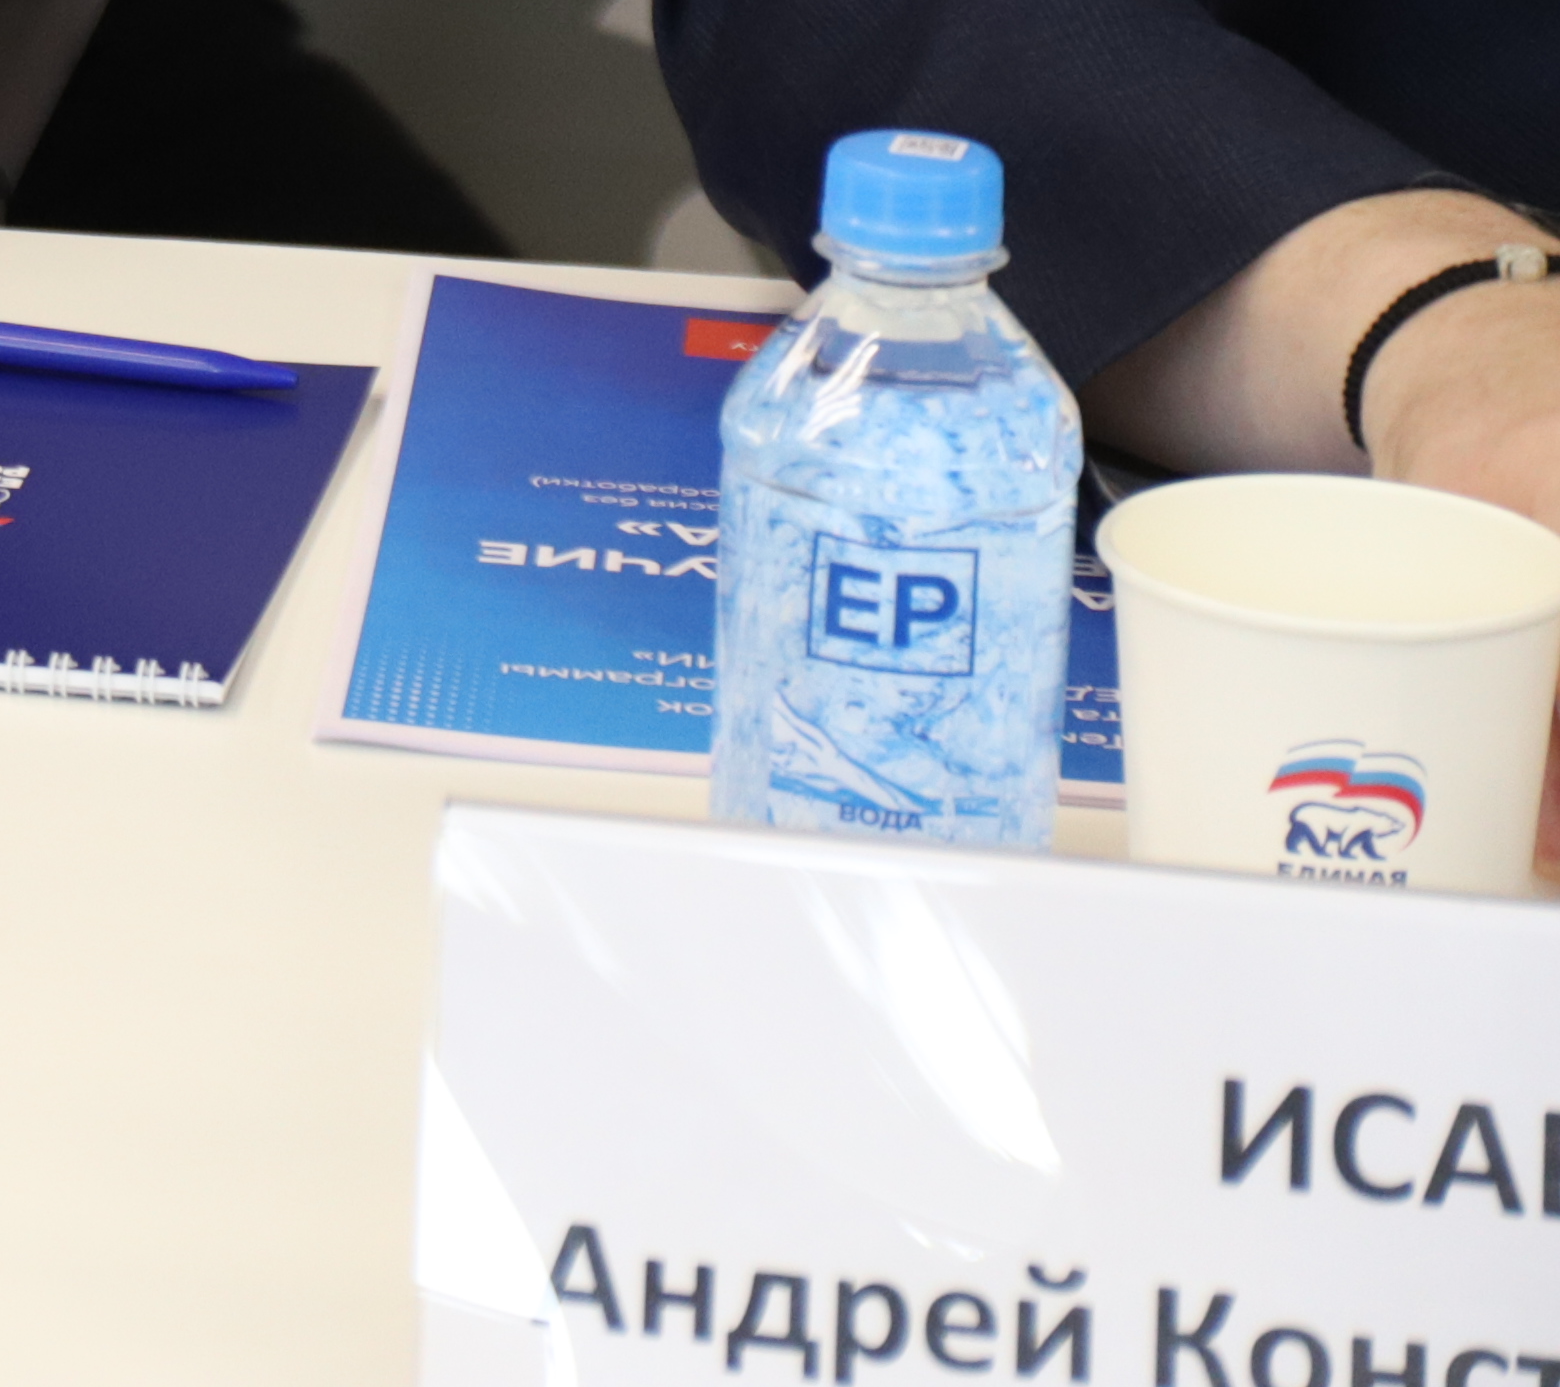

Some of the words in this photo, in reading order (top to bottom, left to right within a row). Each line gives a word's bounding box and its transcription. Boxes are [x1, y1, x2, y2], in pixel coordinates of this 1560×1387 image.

[581, 493, 640, 508] без
[498, 661, 716, 691] ограммы
[656, 699, 714, 717] ок
[547, 1221, 1096, 1387] Андрей
